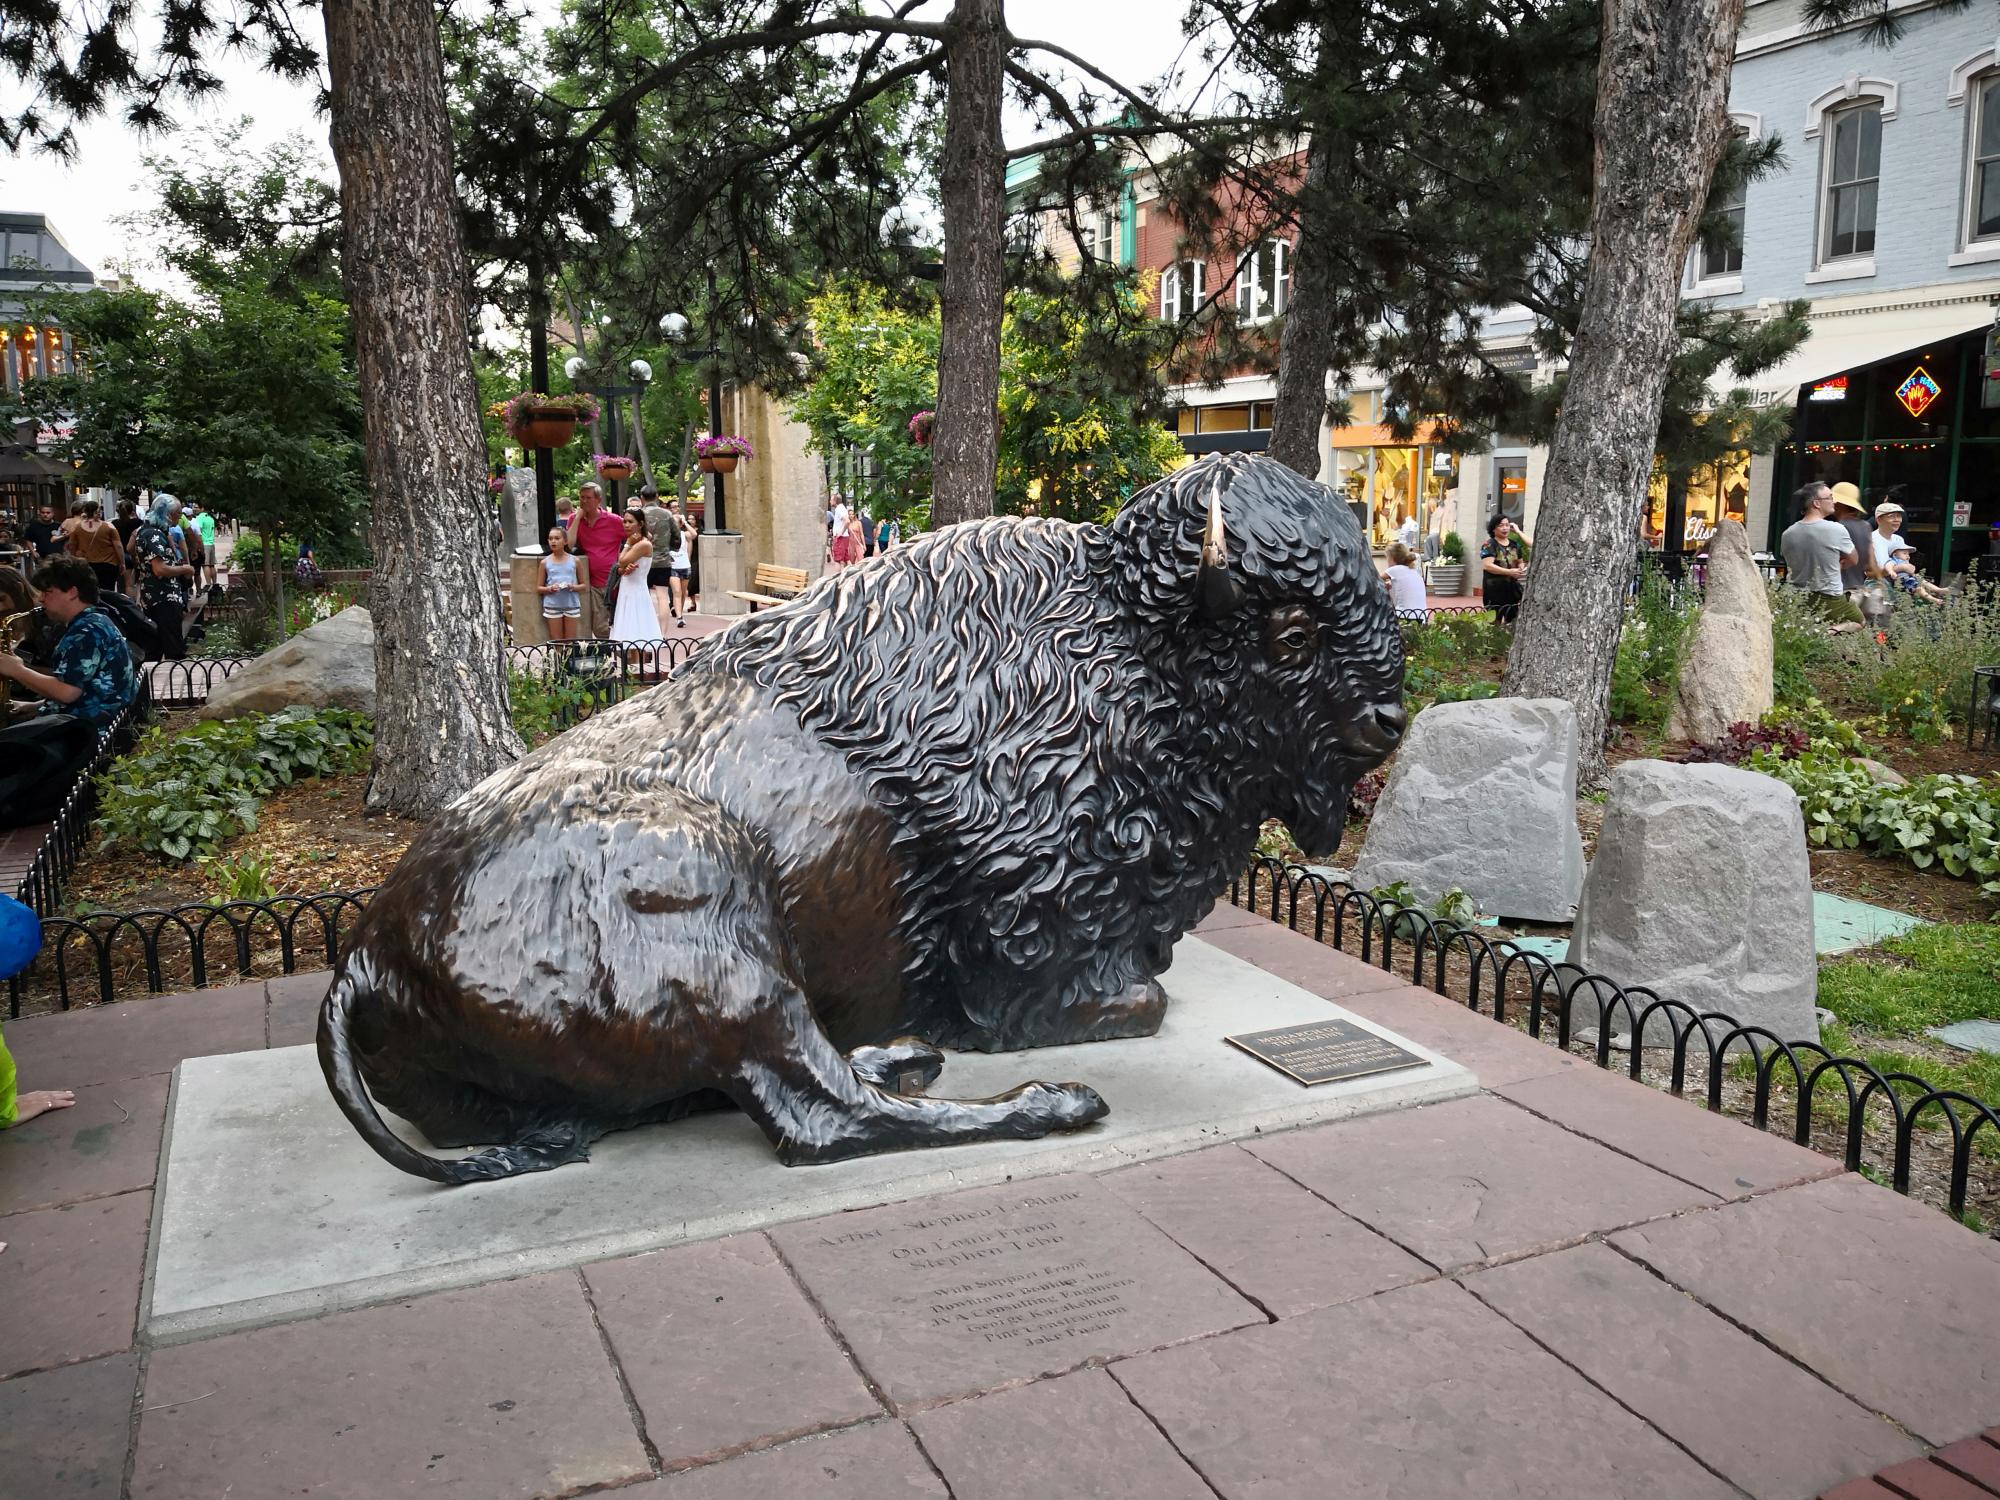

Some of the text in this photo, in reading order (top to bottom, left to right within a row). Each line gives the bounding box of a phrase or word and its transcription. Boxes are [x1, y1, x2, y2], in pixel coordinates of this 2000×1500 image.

[1898, 376, 1938, 397] LEFT HAND
[813, 1226, 883, 1248] Artist
[900, 1206, 995, 1234] Stephen
[886, 1219, 1058, 1260] On Loan From
[908, 1232, 1066, 1274] Stephen Tebo
[932, 1282, 973, 1298] With
[974, 1269, 1040, 1291] Support
